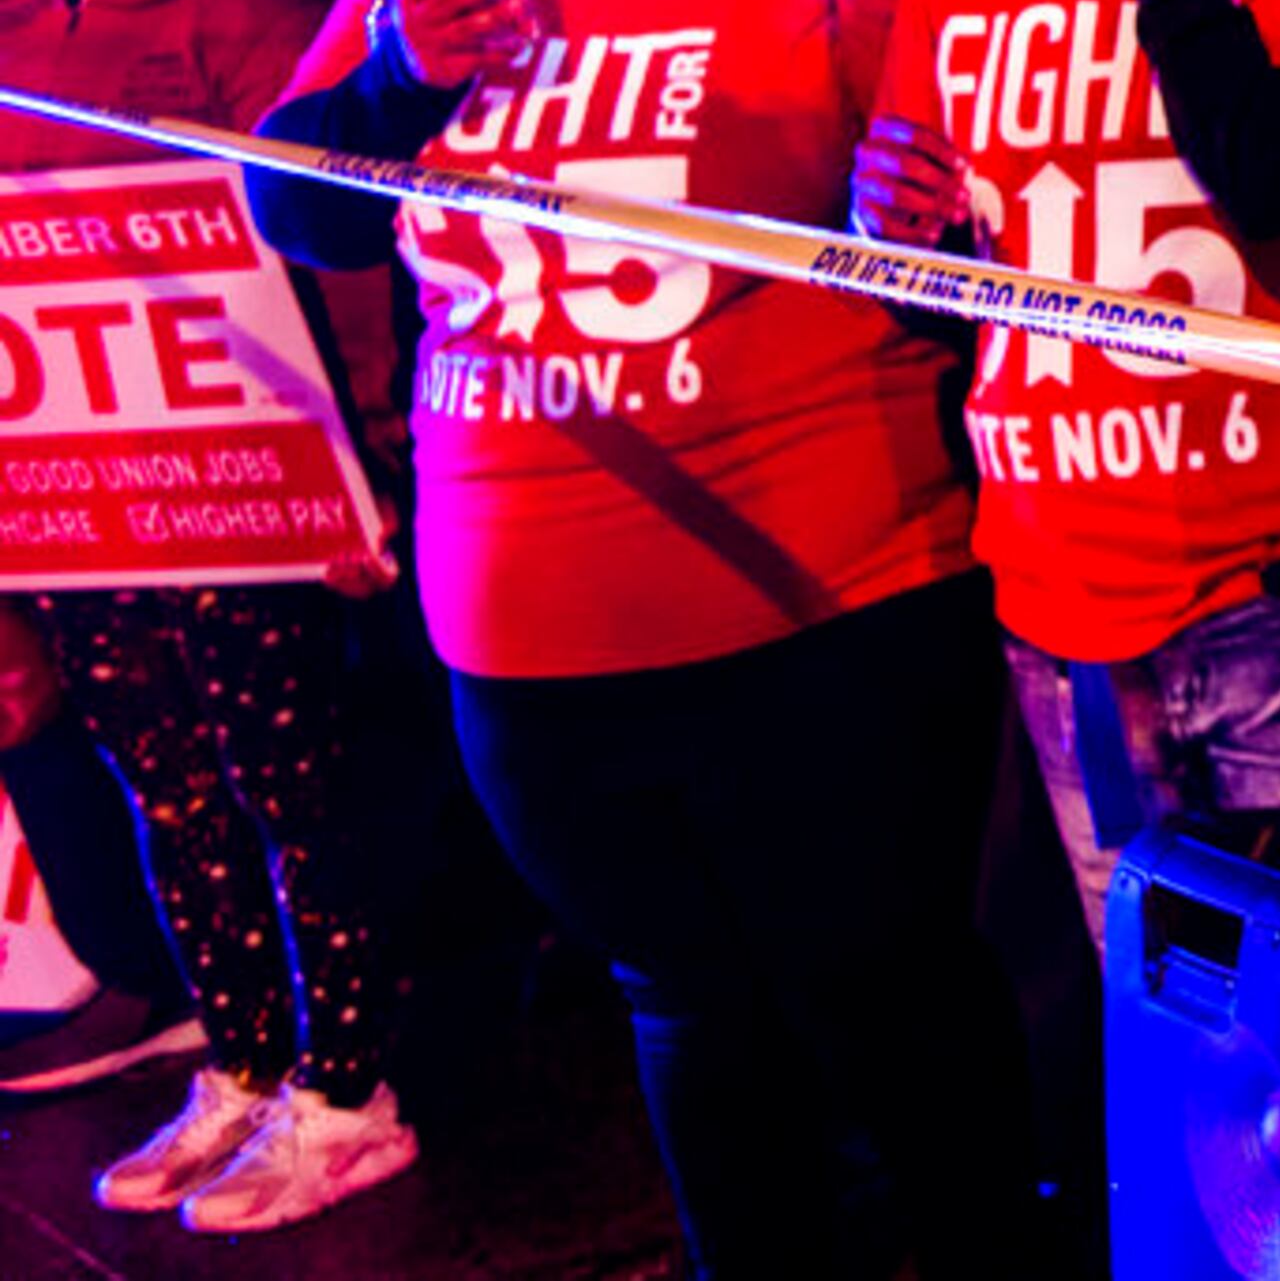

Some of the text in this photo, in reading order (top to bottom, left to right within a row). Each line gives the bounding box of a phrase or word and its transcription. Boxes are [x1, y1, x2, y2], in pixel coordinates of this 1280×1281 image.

[655, 48, 711, 141] FOR
[127, 207, 238, 251] 6TH
[501, 352, 644, 420] NOV.
[666, 338, 701, 403] 6
[1052, 402, 1205, 480] NOV.
[1222, 391, 1259, 463] 6
[5, 447, 283, 494] GOOD UNION JOBS
[167, 499, 289, 540] HIGHER
[286, 494, 347, 536] PAY
